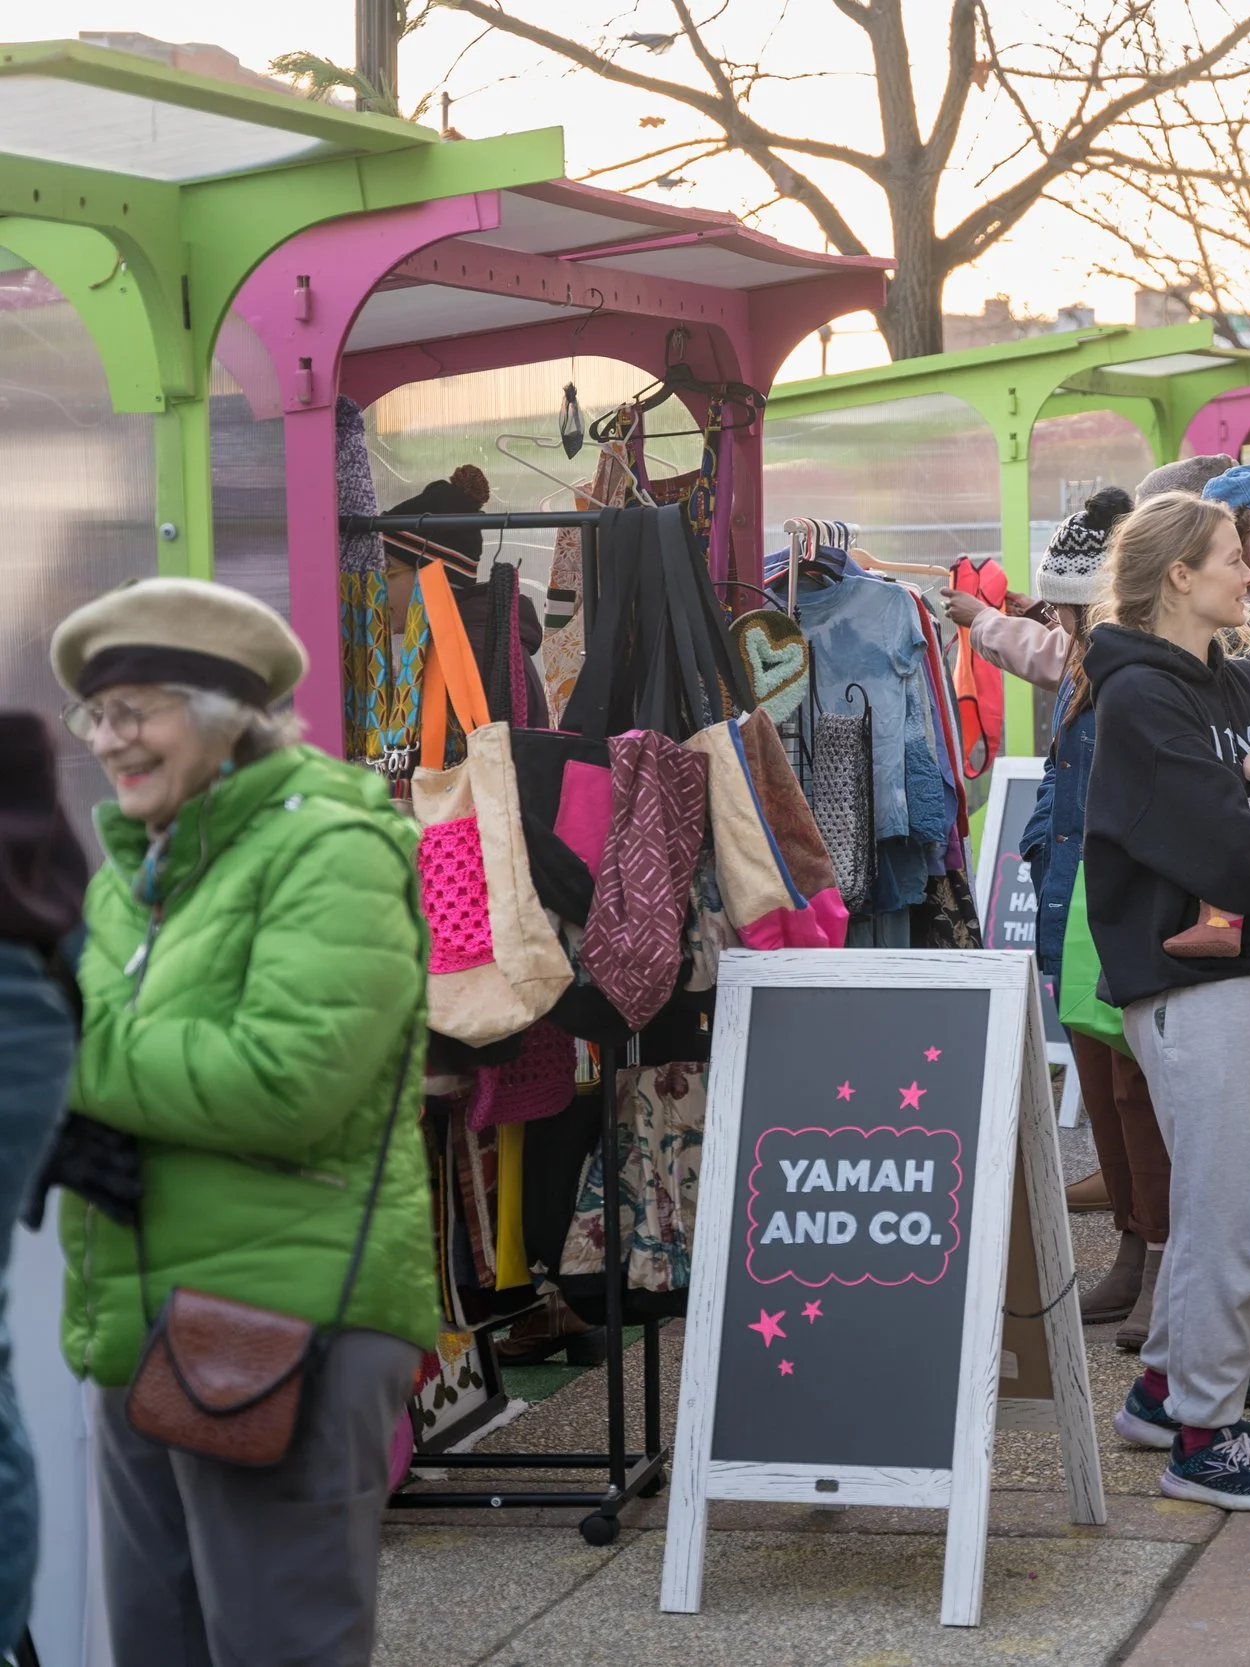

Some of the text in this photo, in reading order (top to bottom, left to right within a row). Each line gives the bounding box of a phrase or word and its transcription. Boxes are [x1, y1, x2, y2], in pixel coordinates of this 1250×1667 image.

[1003, 921, 1037, 942] THI
[779, 1158, 935, 1192] YAMAH
[760, 1211, 942, 1246] AND CO.
